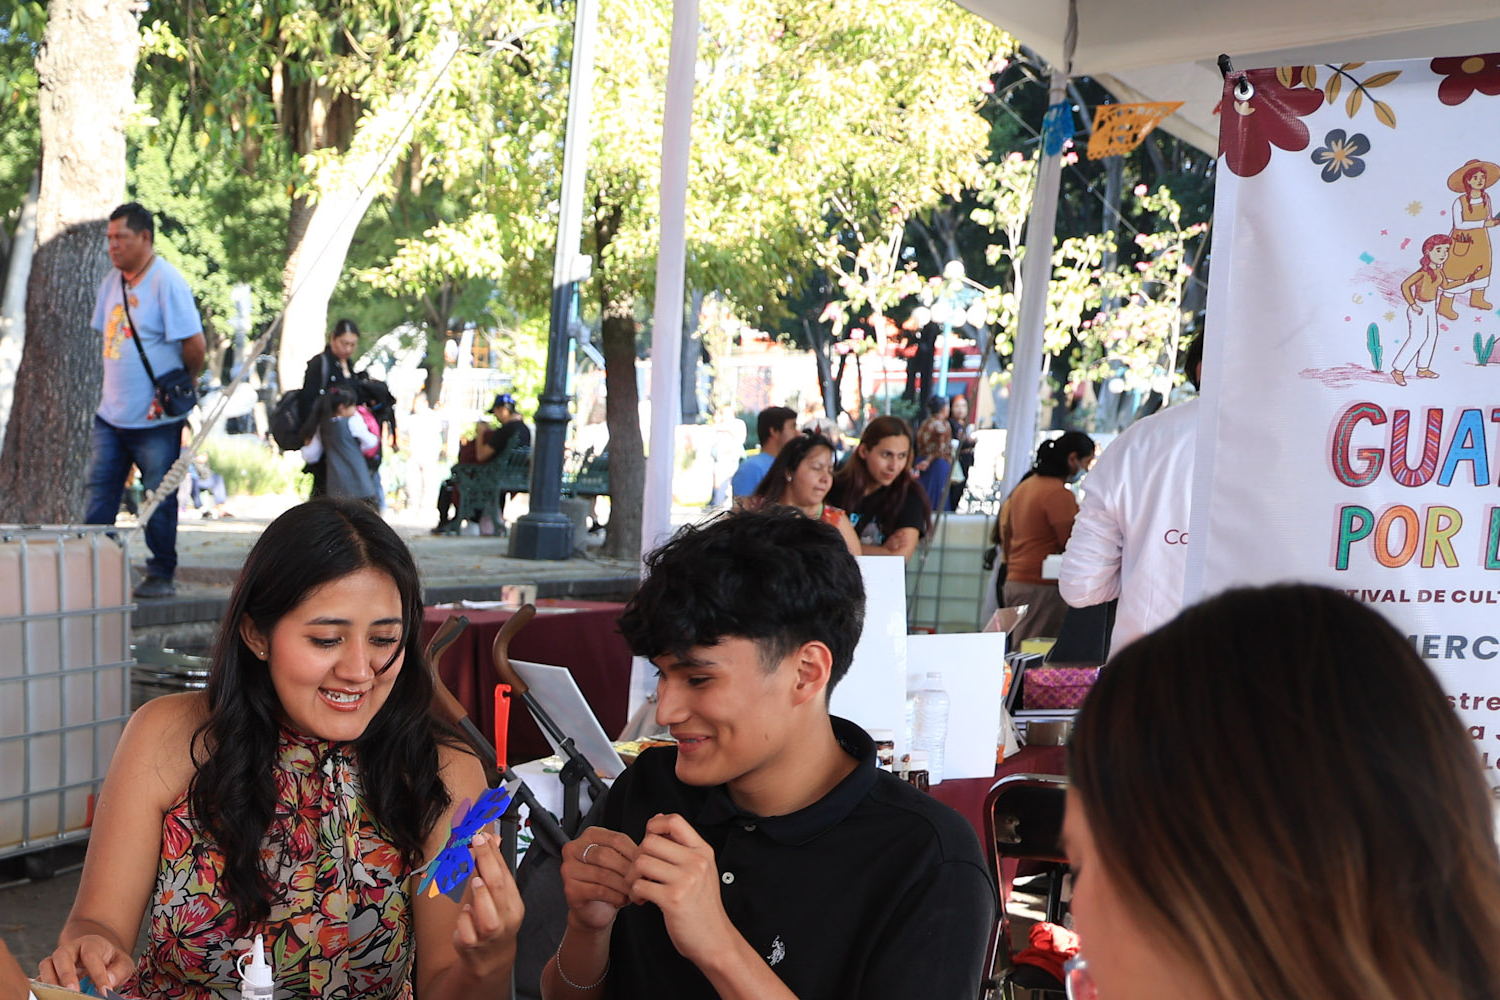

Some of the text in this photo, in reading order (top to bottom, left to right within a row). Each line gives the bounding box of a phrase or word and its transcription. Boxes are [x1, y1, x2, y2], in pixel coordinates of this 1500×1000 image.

[1334, 504, 1464, 571] POR
[1417, 590, 1446, 603] DE
[1451, 590, 1500, 604] CUL
